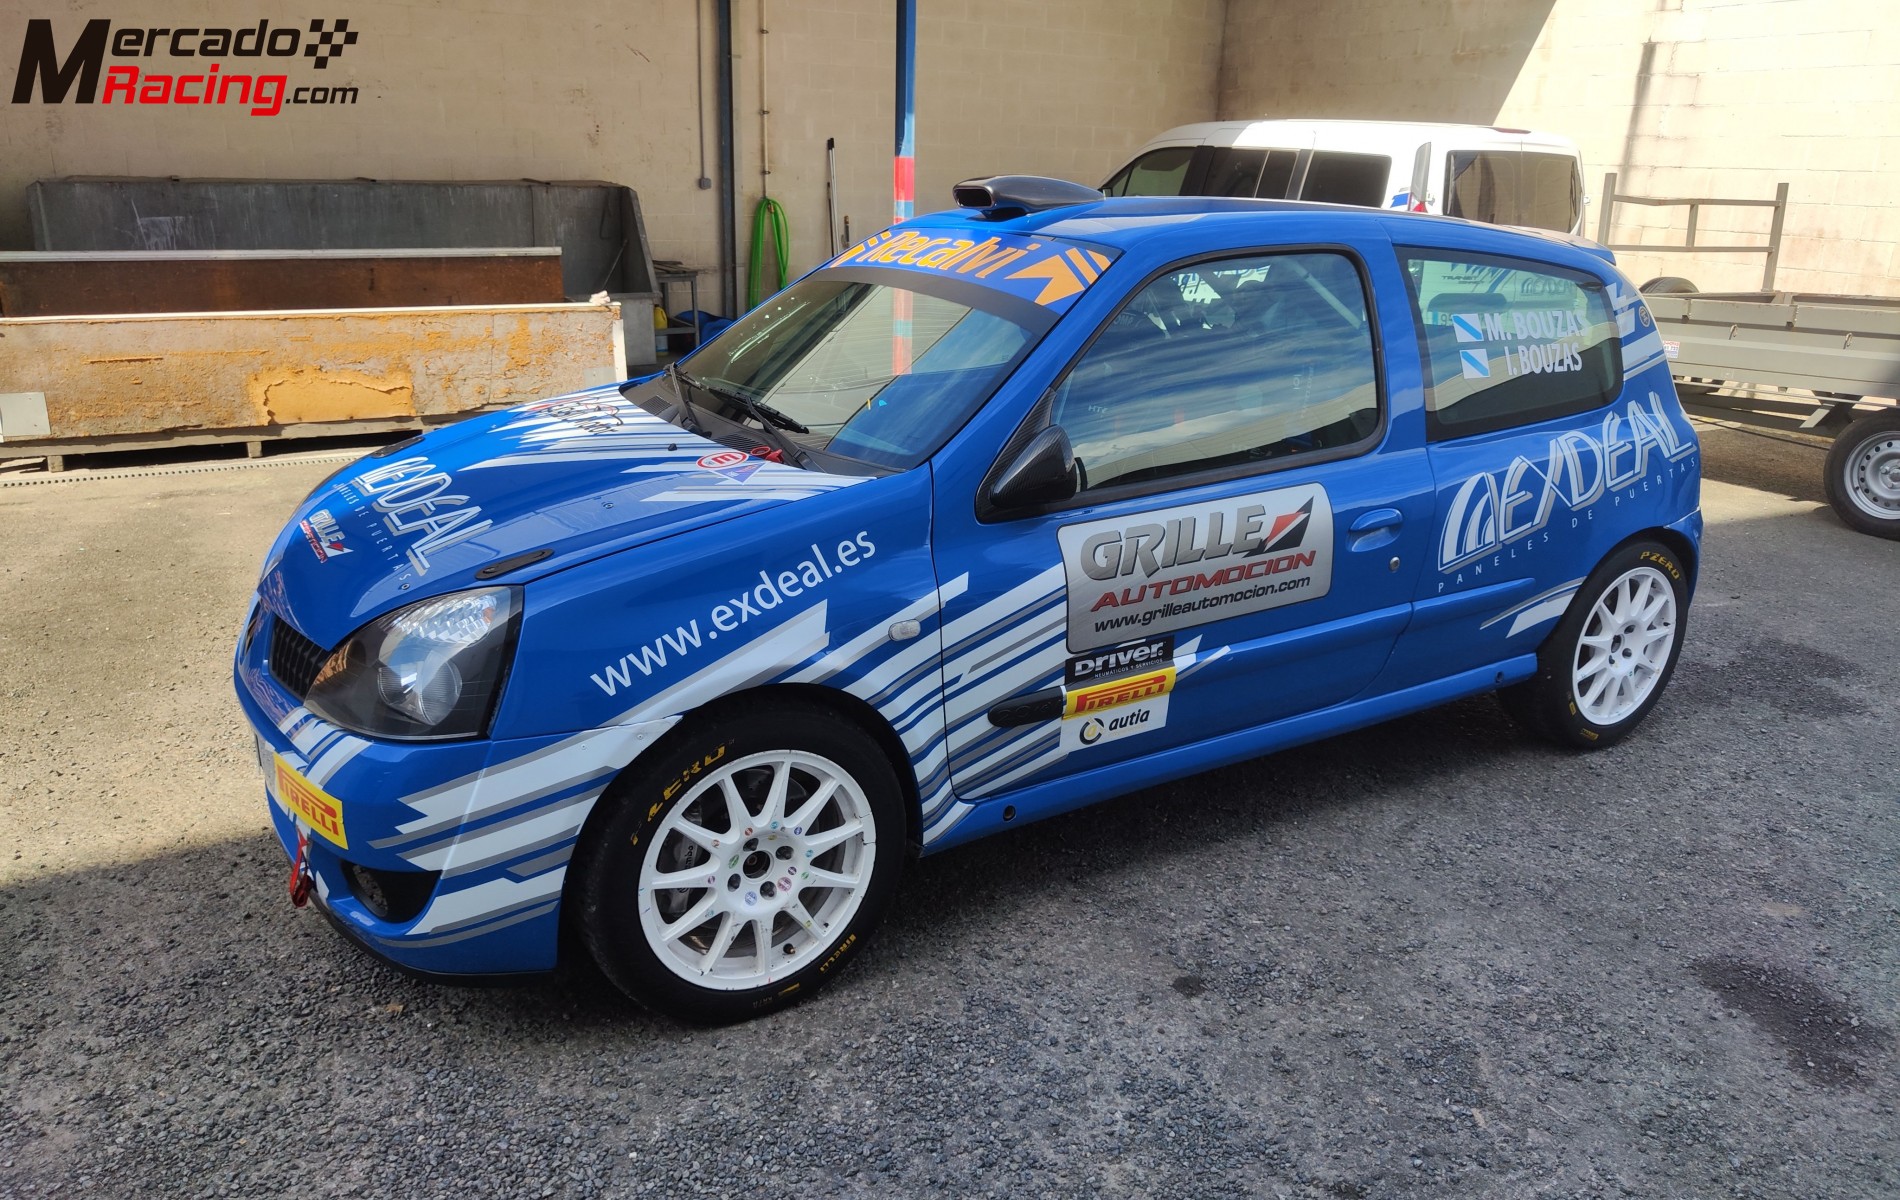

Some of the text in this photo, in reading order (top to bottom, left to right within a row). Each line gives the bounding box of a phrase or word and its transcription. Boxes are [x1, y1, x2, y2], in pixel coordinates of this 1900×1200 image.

[855, 231, 1041, 278] Recalvi
[1484, 313, 1512, 342] M.
[1512, 310, 1590, 340] BOUZAS
[1506, 342, 1583, 376] I. BOUZAS
[1080, 504, 1266, 581] GRILLE
[1438, 458, 1696, 593] PANELES DE PUERTAS
[1090, 550, 1317, 613] AUTOMOCION
[1094, 576, 1311, 633] www.grilleautomocion.com
[590, 530, 876, 697] www.exdeal.es
[1074, 674, 1167, 713] PIRELLI
[1108, 708, 1151, 732] autia
[276, 763, 339, 836] PIRELLI
